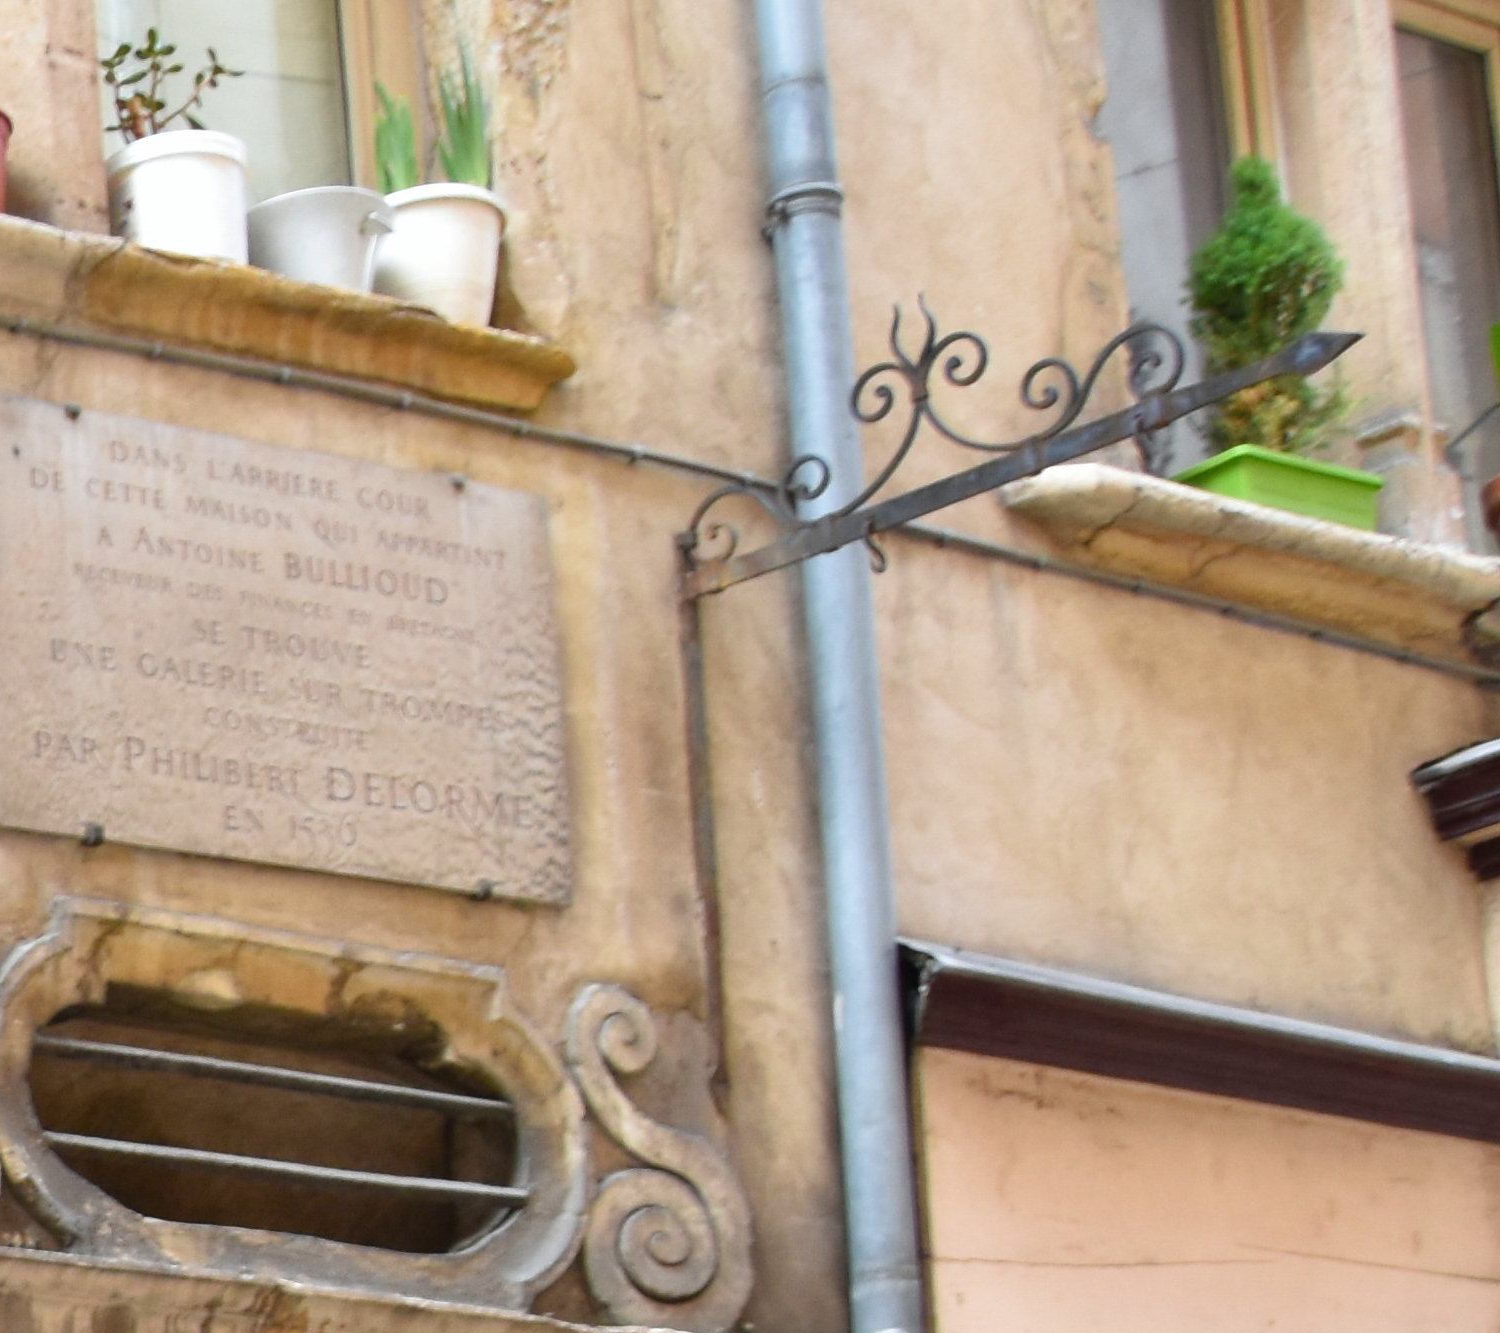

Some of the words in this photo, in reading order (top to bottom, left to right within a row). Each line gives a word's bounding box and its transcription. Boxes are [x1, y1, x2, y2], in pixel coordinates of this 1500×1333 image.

[109, 440, 188, 474] DANS
[356, 485, 432, 522] COUR
[29, 465, 65, 493] DE
[84, 475, 167, 511] CETTE
[183, 493, 293, 531] MAISON
[312, 514, 359, 548] QUI
[375, 528, 507, 571] APPARTINT
[283, 550, 449, 605] BULLIOUD
[192, 617, 226, 647] SE
[242, 624, 371, 671] TROUVE
[50, 637, 116, 672] UNE
[136, 650, 267, 697] GALERIE
[289, 676, 343, 705] SUR
[358, 685, 507, 733] TROMPES
[203, 704, 371, 754] CONSTRUITE
[33, 729, 97, 761] PAR
[326, 765, 536, 831] DELORME
[222, 805, 264, 834] EN
[287, 813, 359, 848] 1536
